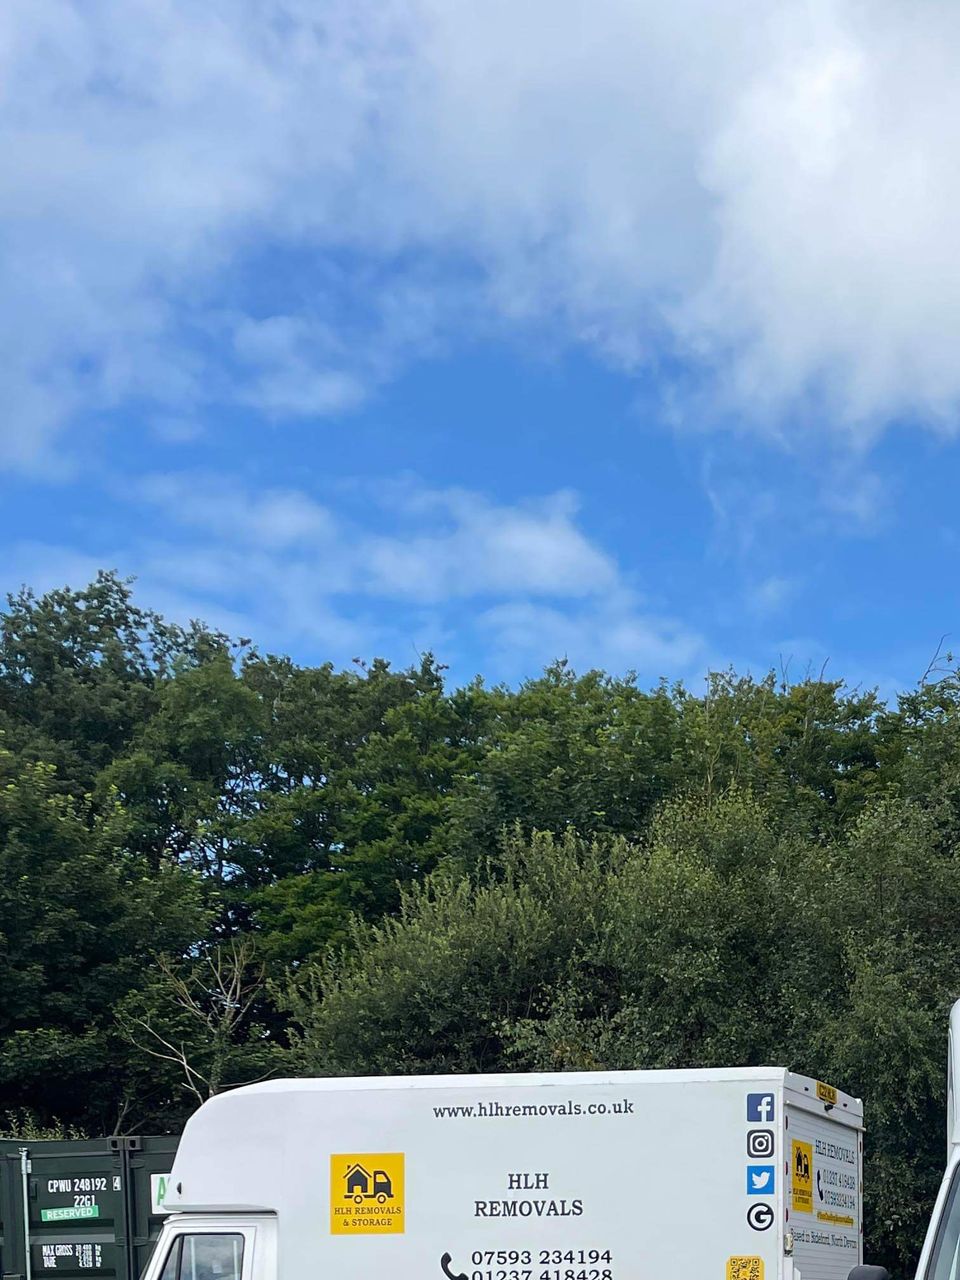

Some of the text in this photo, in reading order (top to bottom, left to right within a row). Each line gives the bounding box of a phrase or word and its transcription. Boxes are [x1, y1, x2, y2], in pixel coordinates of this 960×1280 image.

[433, 1099, 634, 1118] www.hlhremovals.co.uk
[827, 1143, 855, 1164] REMOVALS
[48, 1179, 71, 1193] CPWU
[74, 1178, 107, 1191] 248192
[508, 1173, 549, 1190] HLH
[73, 1195, 95, 1207] 22G1
[474, 1200, 583, 1217] REMOVALS
[47, 1208, 93, 1220] RESERVED
[334, 1207, 401, 1215] HLH REMOVALS
[352, 1218, 392, 1226] STORAGE
[42, 1245, 55, 1256] MAX
[55, 1244, 73, 1256] GROSS
[471, 1250, 613, 1265] 07593 234194
